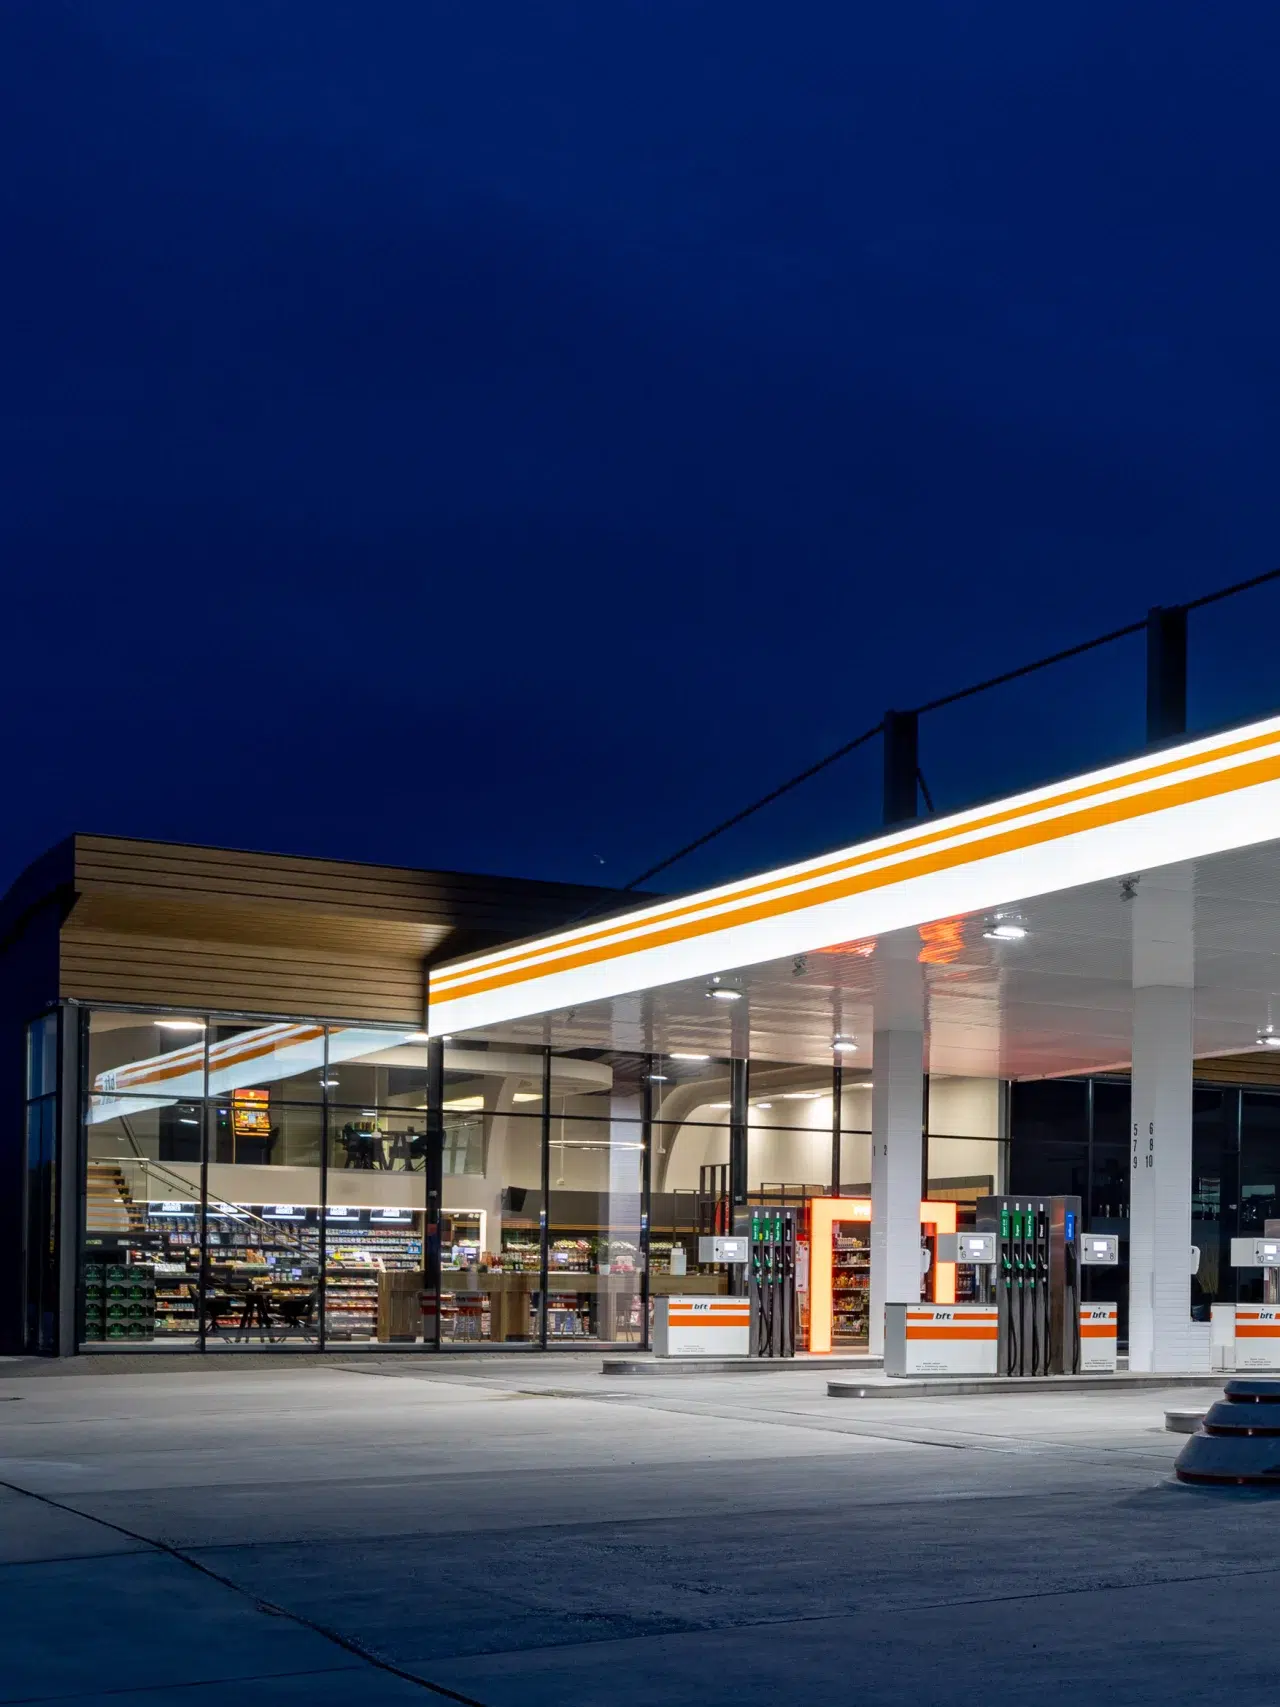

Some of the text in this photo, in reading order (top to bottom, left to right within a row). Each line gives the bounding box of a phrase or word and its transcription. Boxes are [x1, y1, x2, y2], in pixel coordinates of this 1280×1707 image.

[1133, 1122, 1154, 1136] 5 6
[883, 1144, 888, 1156] 2
[1133, 1138, 1154, 1152] 7 8
[1133, 1154, 1153, 1169] 9 10
[961, 1250, 967, 1259] 6
[1109, 1252, 1114, 1260] 8
[935, 1312, 952, 1320] bft
[1092, 1311, 1107, 1319] bft
